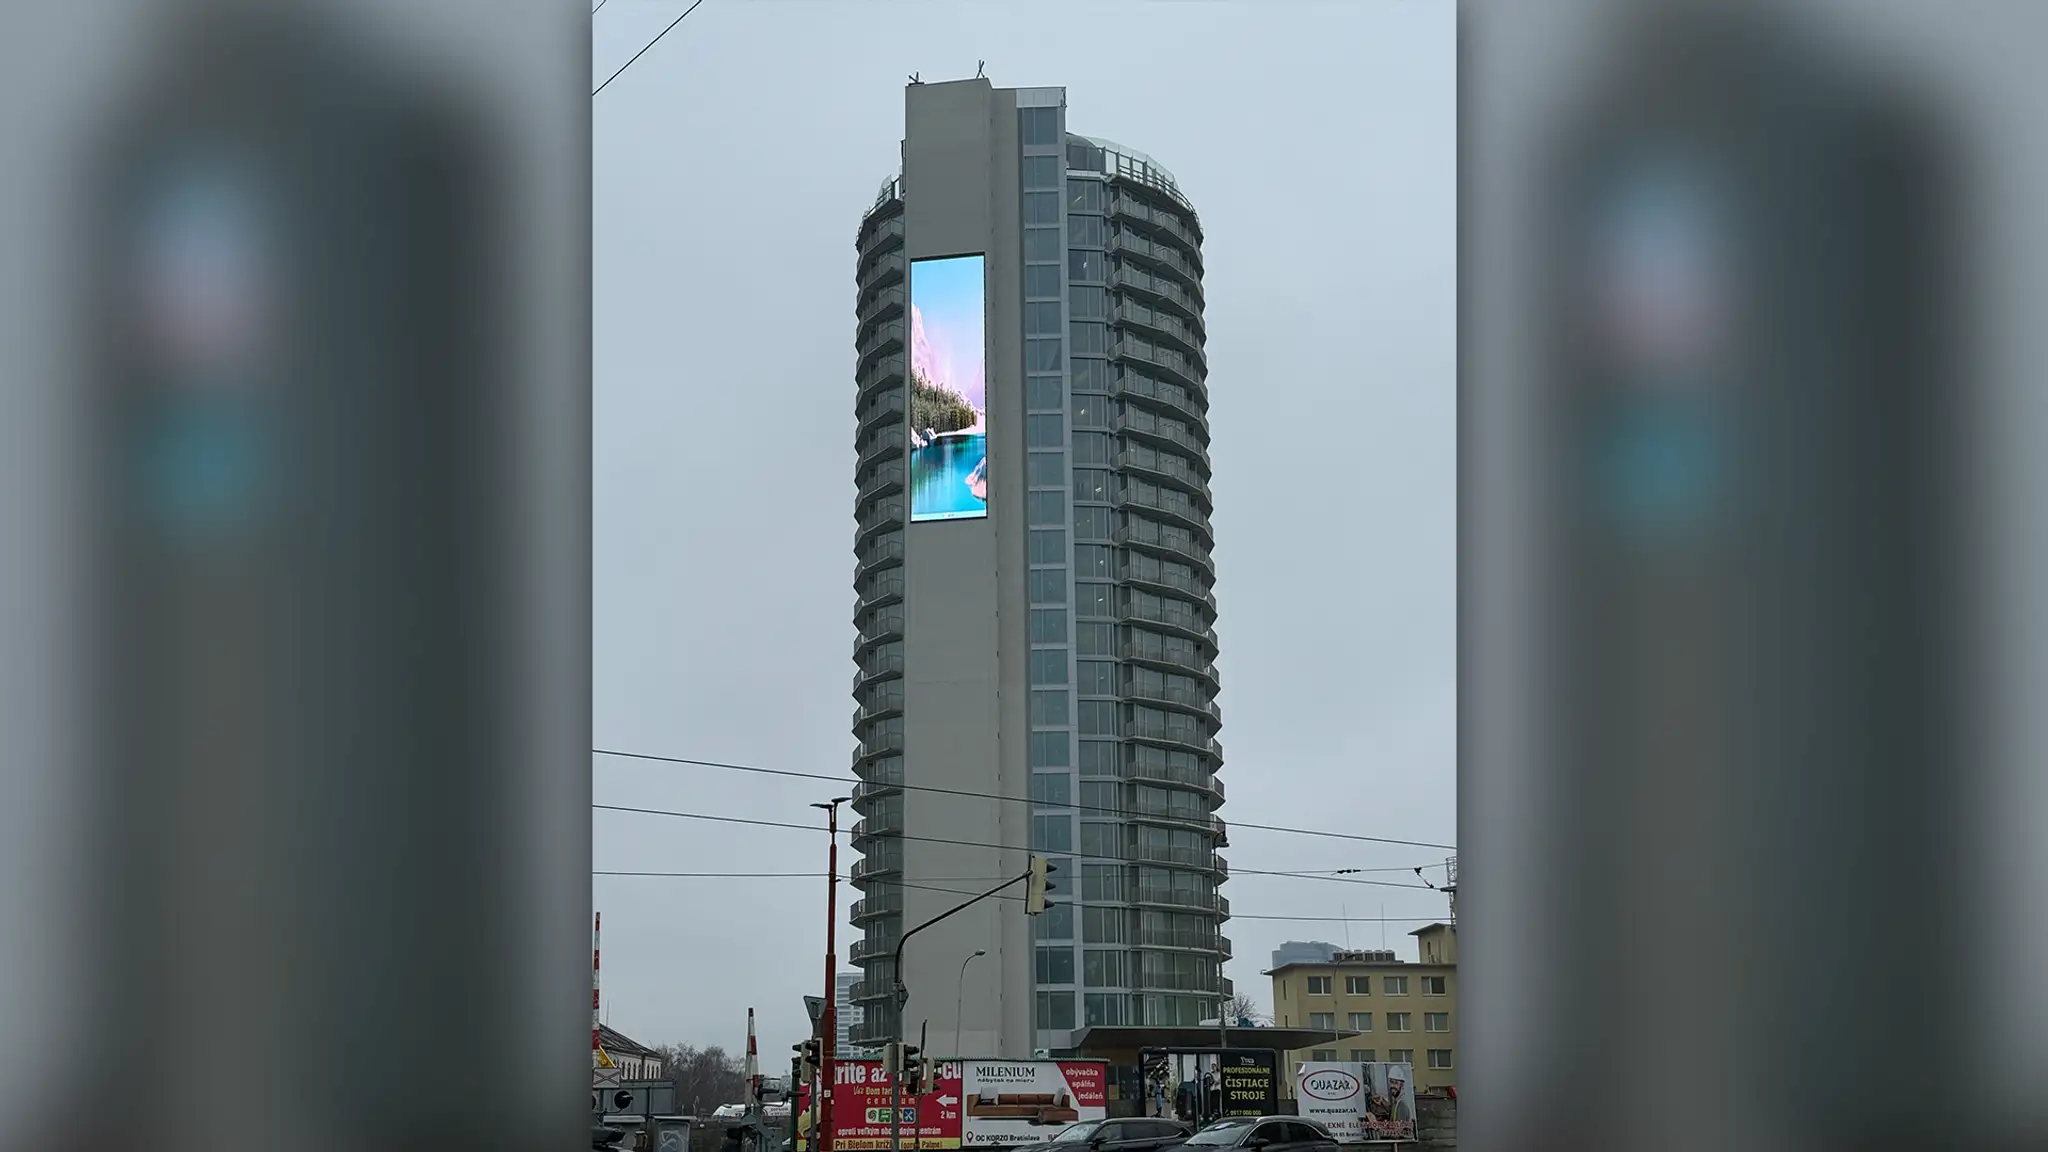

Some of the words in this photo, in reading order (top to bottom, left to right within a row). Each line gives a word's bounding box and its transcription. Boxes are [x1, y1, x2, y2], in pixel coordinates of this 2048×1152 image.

[976, 1066, 1035, 1077] MILENIUM
[1066, 1067, 1099, 1078] obývačka
[1071, 1080, 1096, 1089] spálňa
[1225, 1075, 1270, 1088] ČISTIACE
[865, 1086, 880, 1095] Dom
[1230, 1090, 1266, 1100] STROJE
[866, 1097, 916, 1105] centum
[1078, 1091, 1104, 1101] jedáleň
[940, 1110, 945, 1119] 2
[946, 1110, 957, 1119] km
[1309, 1106, 1357, 1115] www.quazar.sk
[838, 1126, 856, 1137] oproti
[976, 1134, 985, 1142] OC
[986, 1134, 1009, 1142] KORZO
[1009, 1134, 1040, 1142] Bratislava
[835, 1140, 846, 1149] Pri
[848, 1140, 873, 1150] Bielom
